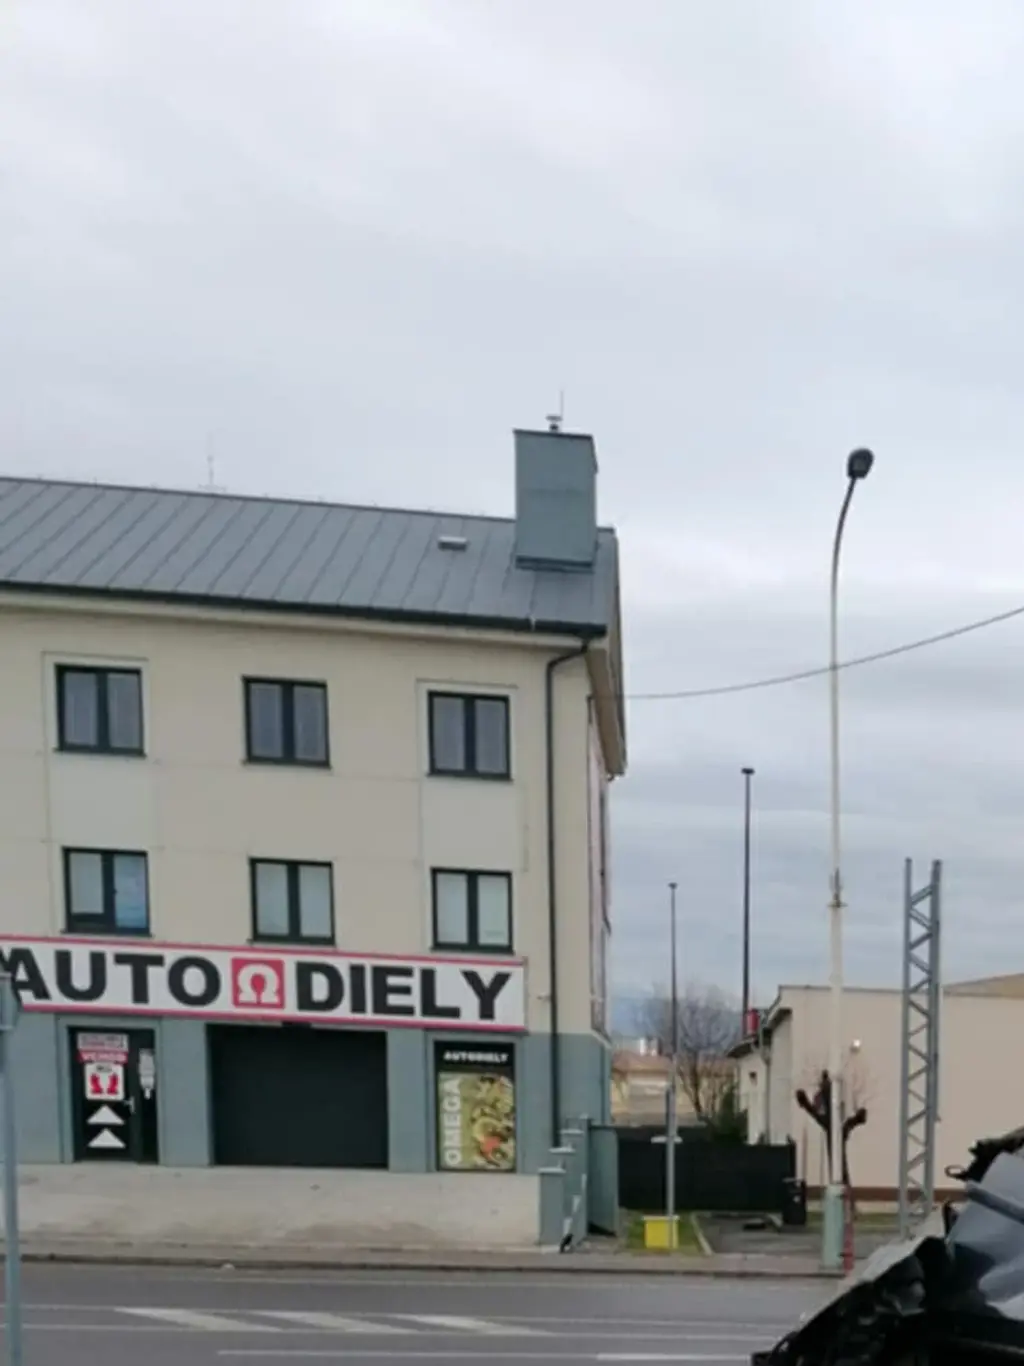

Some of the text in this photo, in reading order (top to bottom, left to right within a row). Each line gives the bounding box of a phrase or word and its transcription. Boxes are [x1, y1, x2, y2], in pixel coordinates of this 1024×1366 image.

[7, 947, 512, 1020] AUTO DIELY
[443, 1078, 462, 1166] OMEGA
